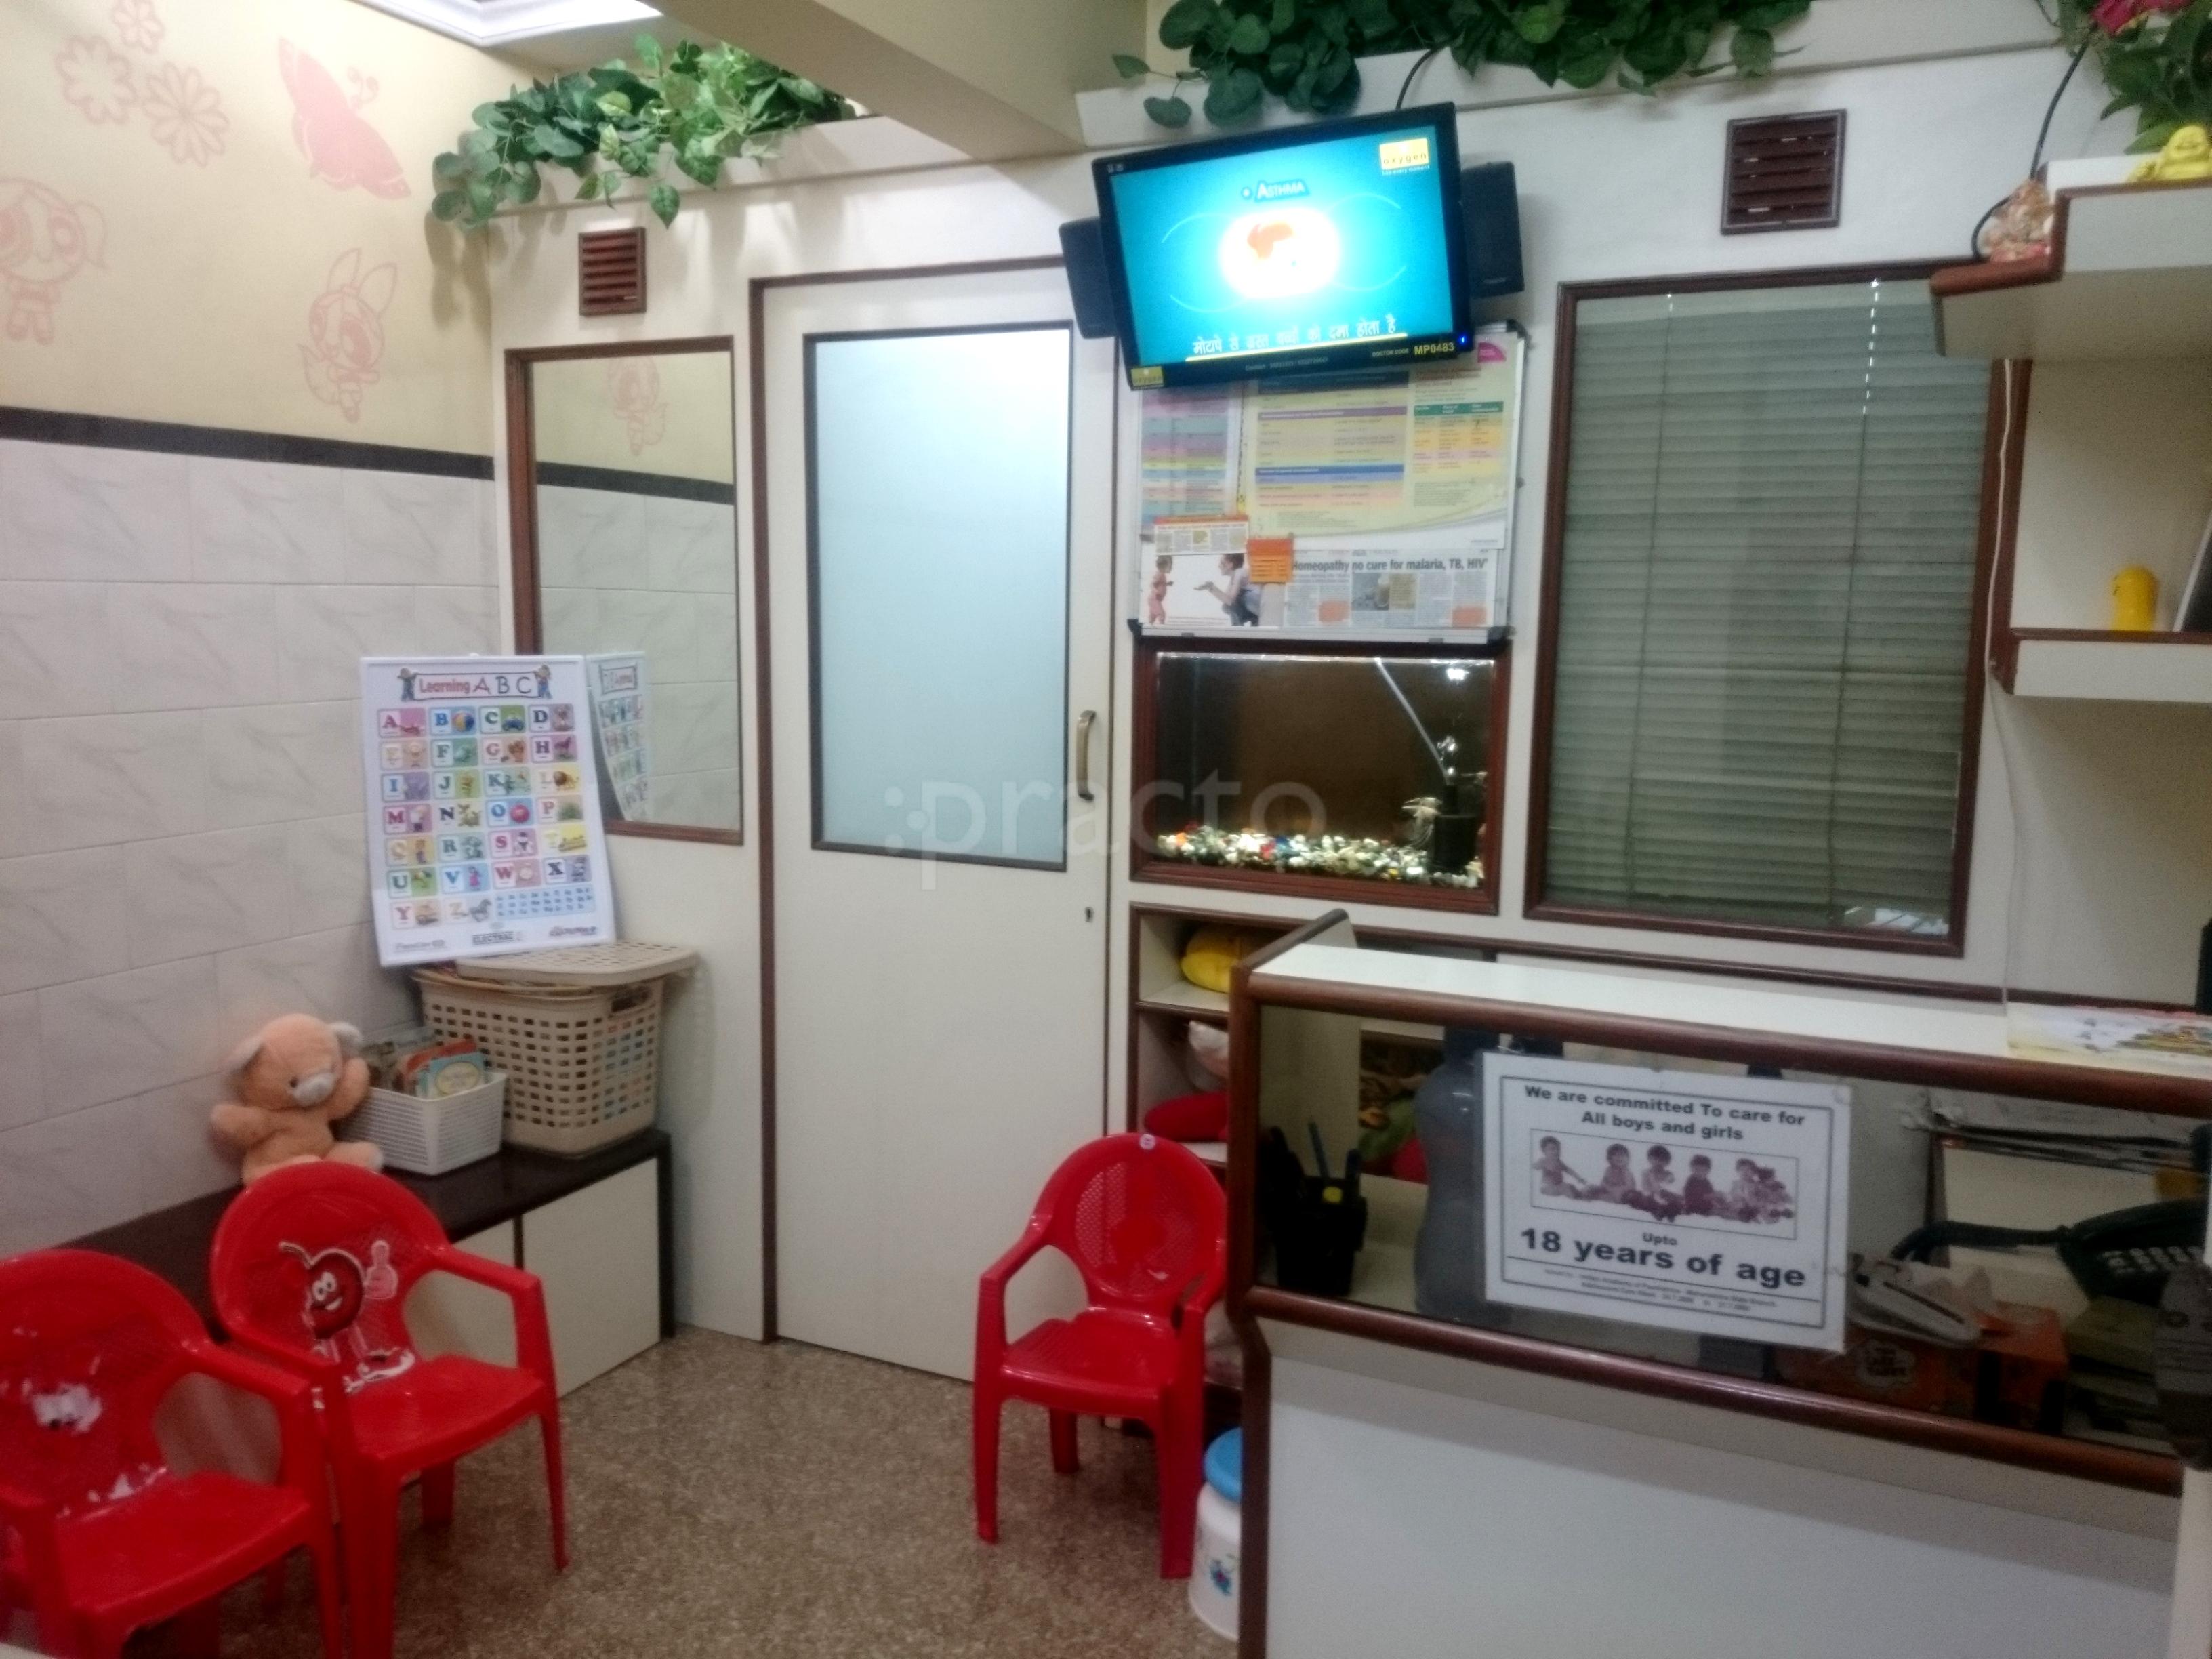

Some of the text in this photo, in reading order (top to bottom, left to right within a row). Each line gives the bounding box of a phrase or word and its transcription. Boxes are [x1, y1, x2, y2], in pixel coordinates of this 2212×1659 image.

[1383, 153, 1427, 165] oxygen
[1414, 342, 1455, 356] MP0483
[1352, 560, 1363, 571] no
[1366, 560, 1387, 571] cure
[1390, 558, 1404, 570] for
[1406, 558, 1446, 571] malaria,
[419, 679, 470, 695] Learning
[382, 710, 548, 729] A B C D
[436, 744, 450, 758] F
[486, 743, 500, 756] G
[535, 741, 550, 754] H
[390, 779, 398, 792] I
[439, 776, 451, 790] J
[388, 801, 555, 825] M N O P
[443, 839, 457, 853] R
[495, 835, 508, 849] S
[392, 862, 563, 889] U V W X
[396, 906, 411, 920] Y
[1525, 1084, 1805, 1126] We are committed To care for
[1581, 1110, 1744, 1141] All boys and girls
[1642, 1231, 1677, 1247] Upto
[1520, 1227, 1806, 1290] 18 years of age
